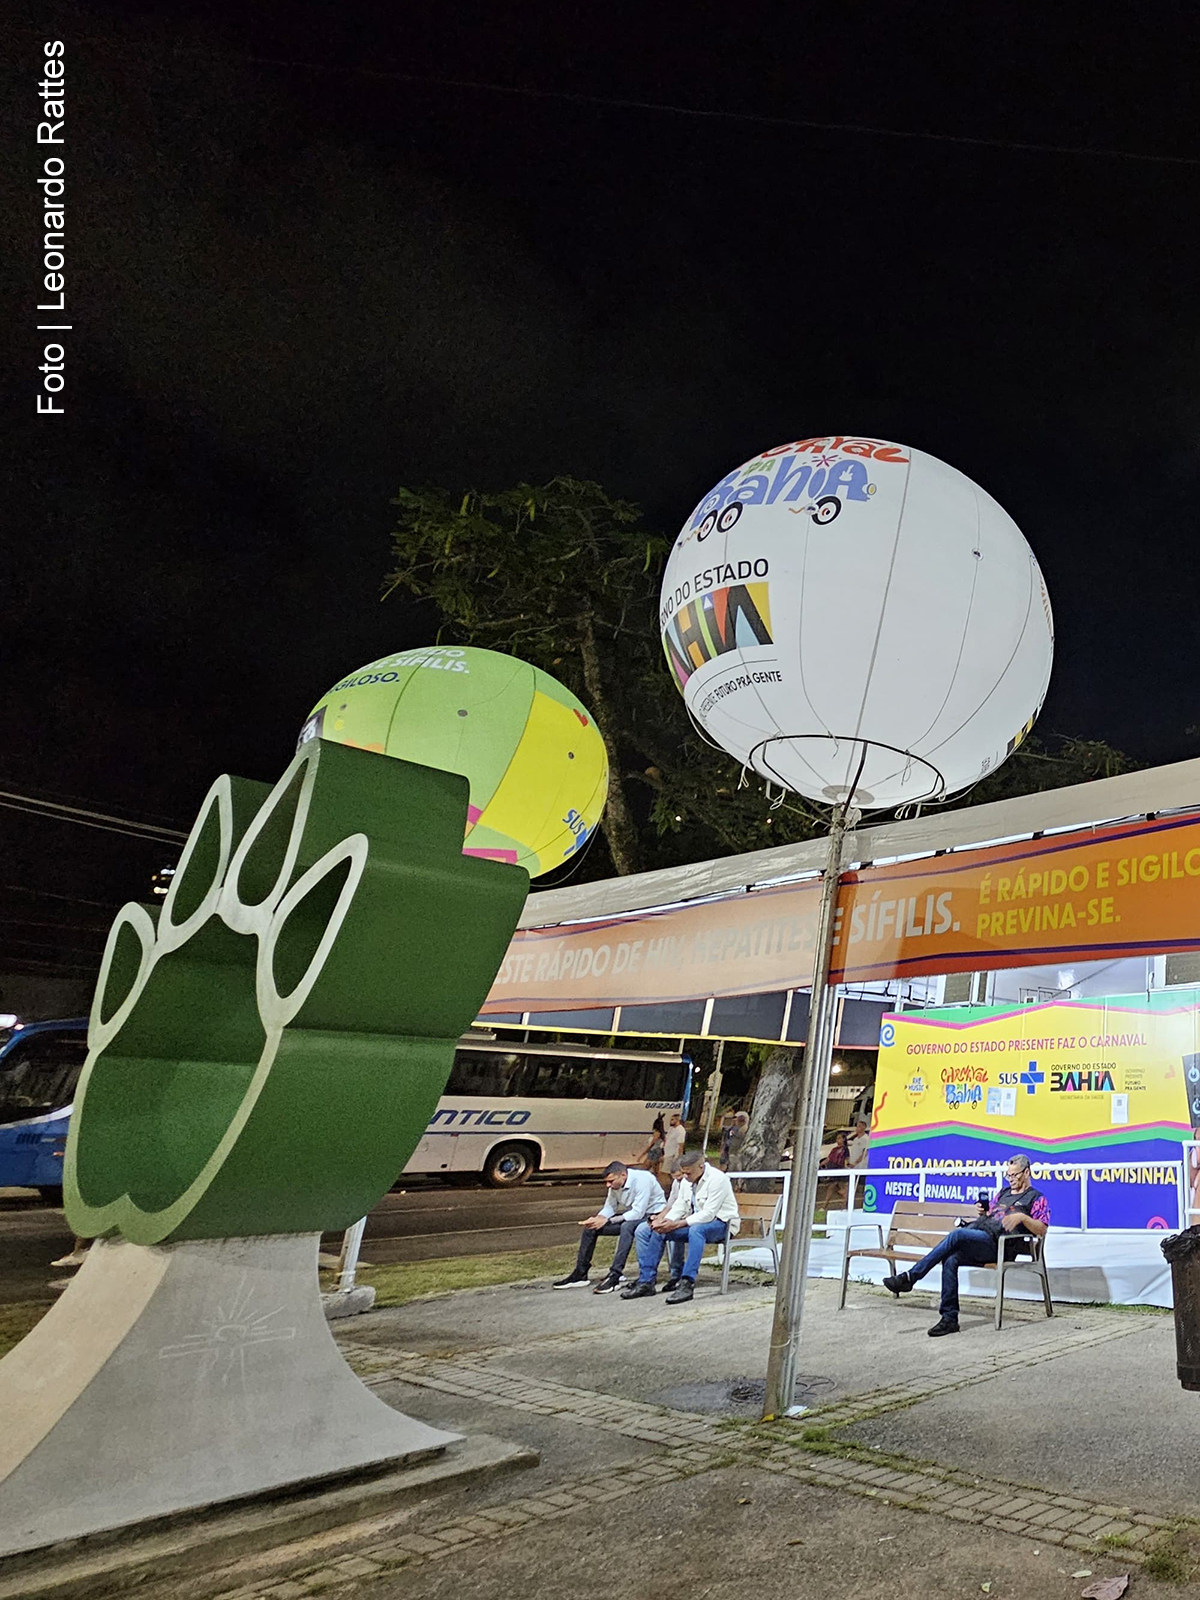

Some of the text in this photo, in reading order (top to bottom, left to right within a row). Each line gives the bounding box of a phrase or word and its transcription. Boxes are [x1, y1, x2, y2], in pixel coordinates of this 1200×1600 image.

[675, 581, 691, 606] DO
[694, 558, 770, 593] ESTADO
[735, 675, 752, 691] PRA
[753, 671, 783, 684] GENTE
[562, 808, 586, 835] SUS
[979, 873, 993, 905] É
[997, 864, 1090, 903] RÁPIDO
[1096, 861, 1110, 889] E
[976, 897, 1122, 939] PREVINA-SE.
[534, 941, 612, 982] RÁPIDO
[612, 940, 645, 976] DE
[849, 890, 961, 944] SÍFILIS.
[906, 1033, 1148, 1056] GOVERNO DO ESTADO PRESENTE FAZ O CARNAVAL
[1051, 1062, 1117, 1072] GOVERNO DO ESTADO
[998, 1072, 1019, 1085] SUS
[1050, 1071, 1116, 1092] BAHIA
[888, 1156, 923, 1170] TODO
[925, 1158, 964, 1177] AMOR
[965, 1159, 993, 1178] FICA
[885, 1181, 912, 1197] NESTE
[913, 1183, 966, 1202] CRNAVAL,
